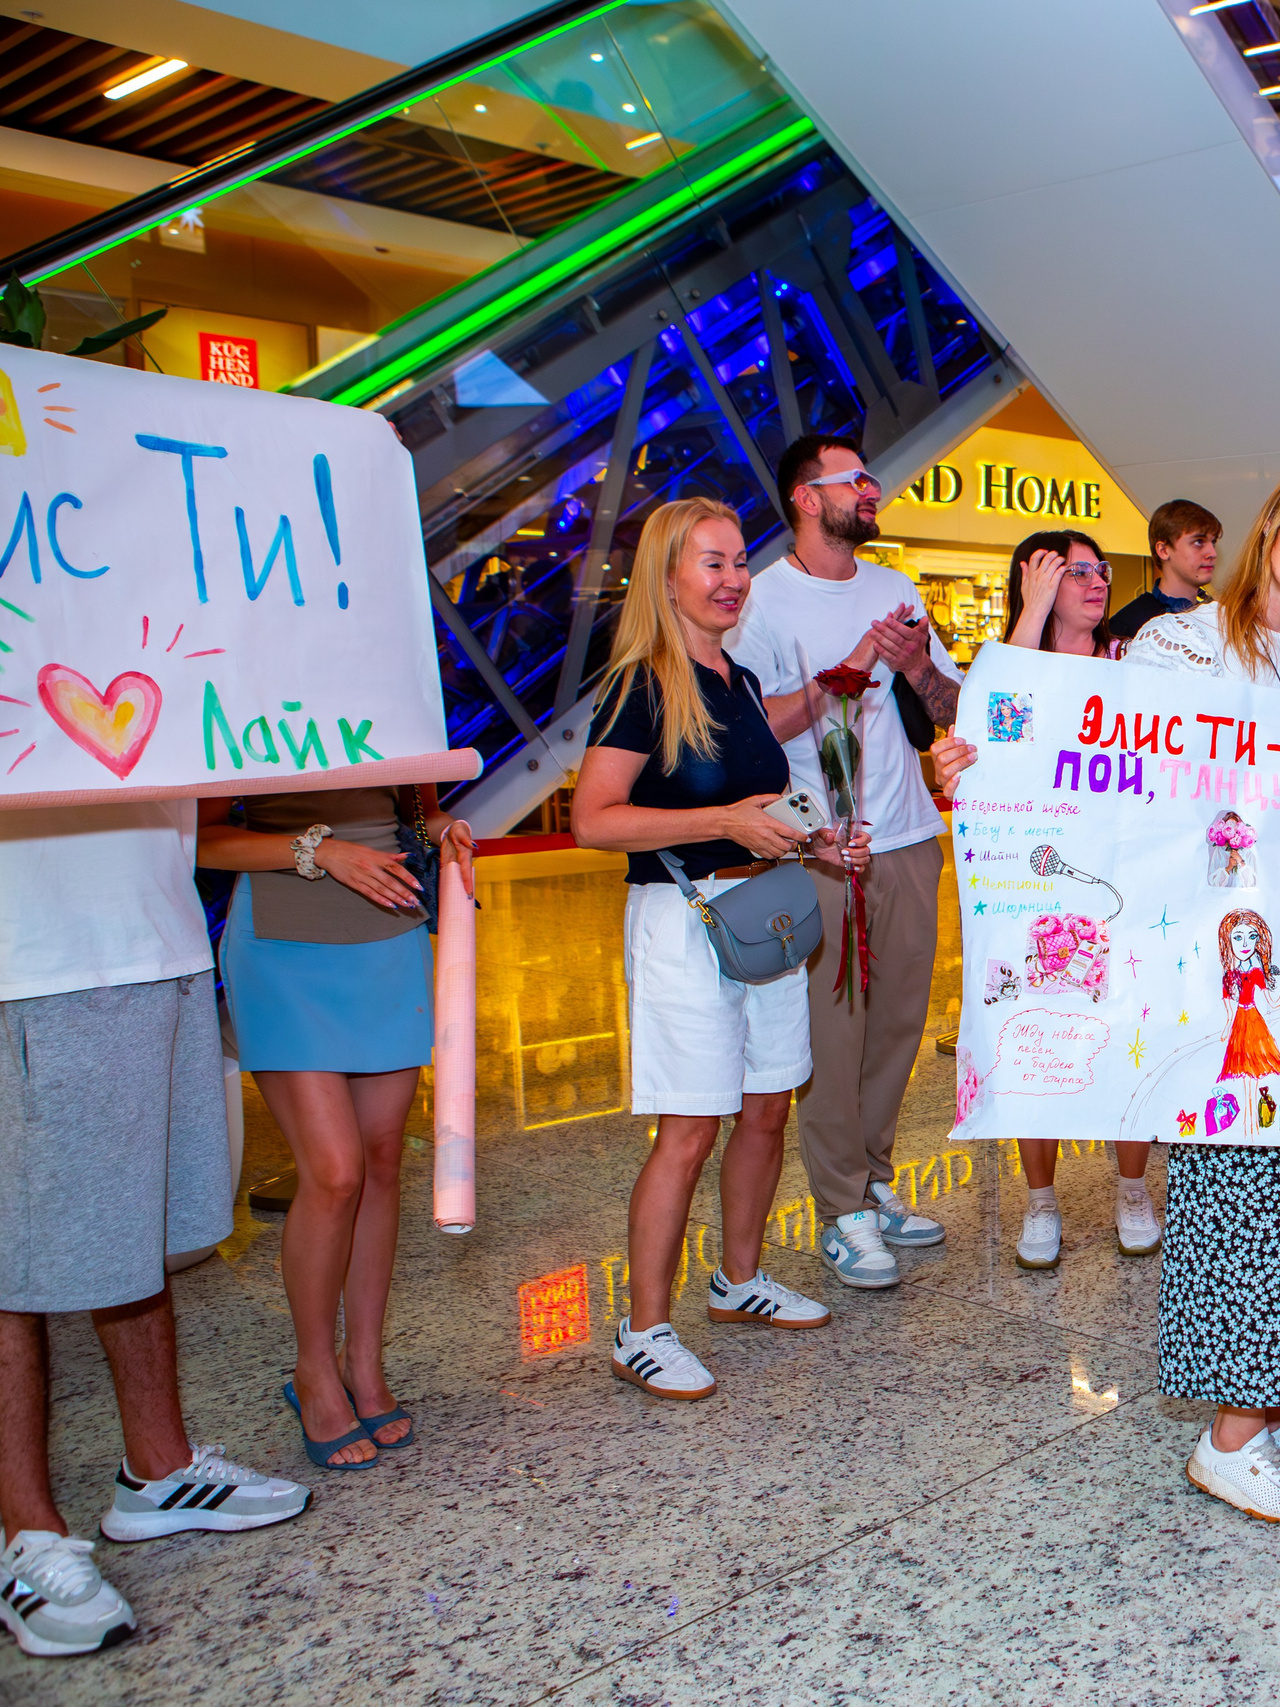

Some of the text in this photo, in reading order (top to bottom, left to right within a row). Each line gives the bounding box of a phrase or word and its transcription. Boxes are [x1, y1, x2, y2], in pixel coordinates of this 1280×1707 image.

[209, 355, 251, 373] HEN
[978, 463, 1101, 519] HOME
[135, 433, 349, 609] Ти!
[203, 680, 385, 770] Лайк
[1078, 695, 1184, 755] ЭЛИС
[1053, 750, 1155, 804] ПОЙ,
[1025, 826, 1064, 837] мечте
[982, 876, 1054, 892] Чемпионы
[1013, 1024, 1044, 1047] Жду
[1017, 1045, 1055, 1055] песен
[1022, 1073, 1037, 1081] от
